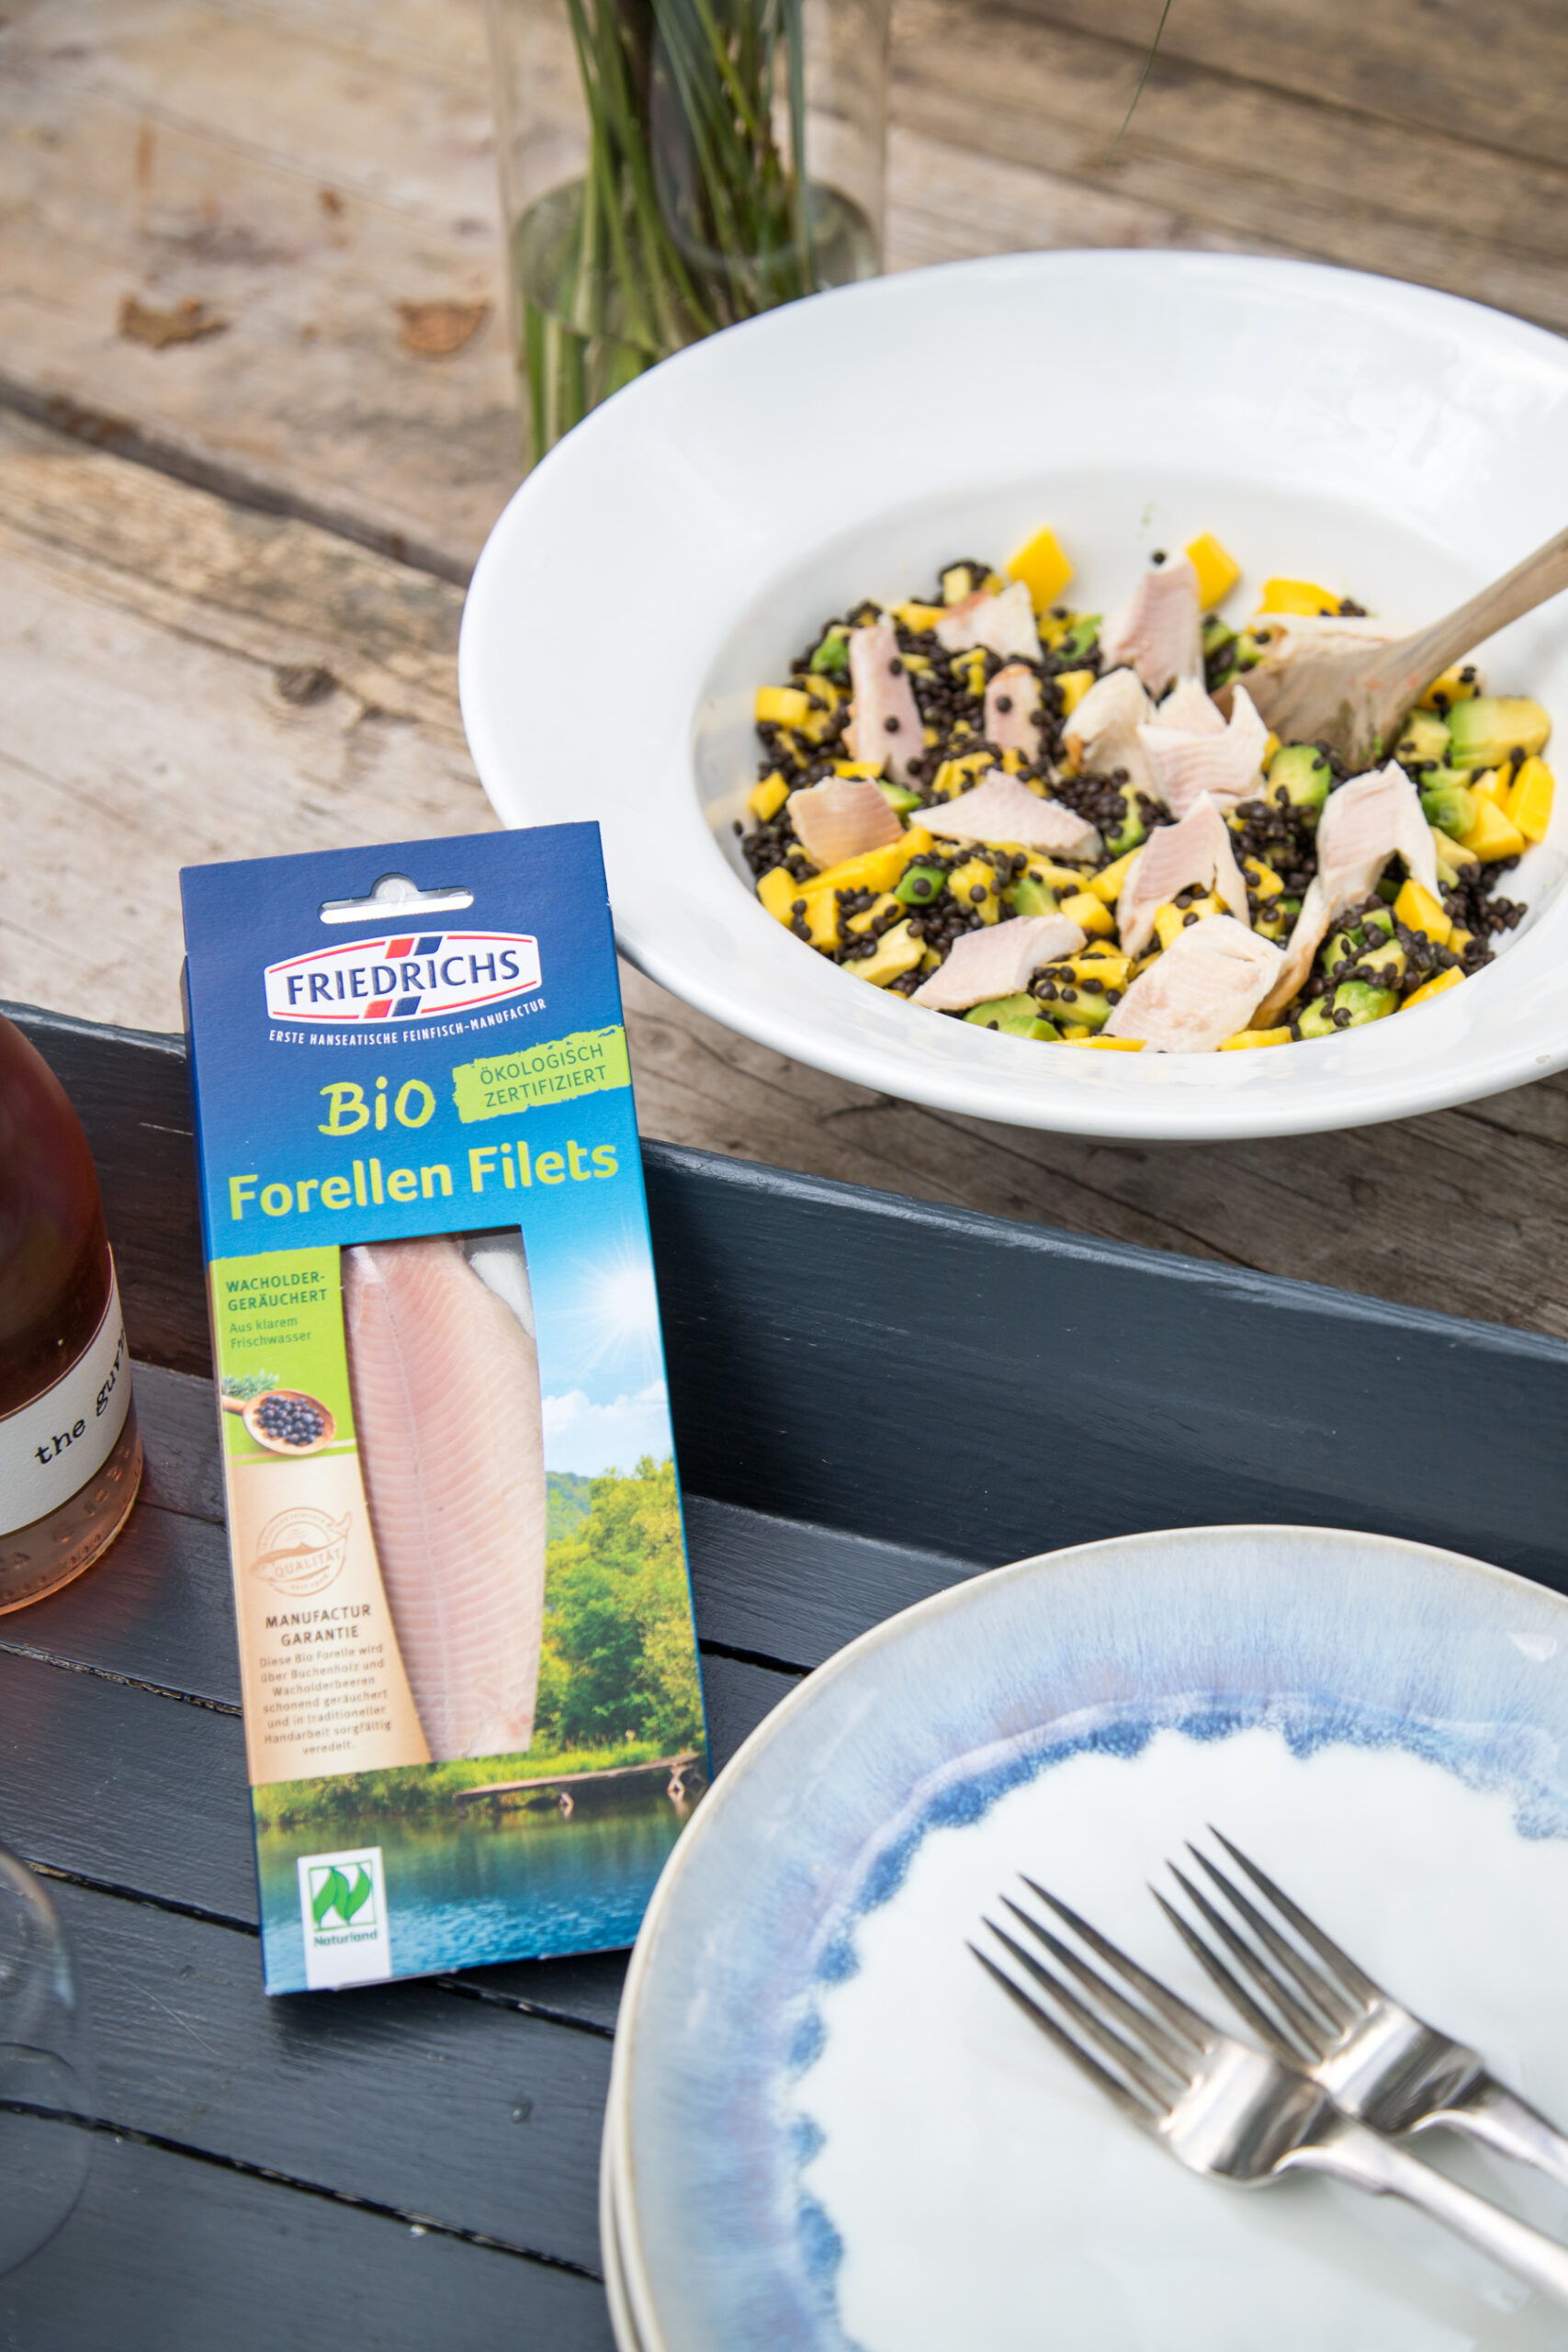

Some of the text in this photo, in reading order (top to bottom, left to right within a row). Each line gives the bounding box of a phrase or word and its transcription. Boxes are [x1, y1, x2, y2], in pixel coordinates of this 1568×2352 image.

[286, 950, 520, 1005] FRIEDRICHS
[269, 998, 547, 1046] ERSTE HANSEATISCHE FEINFISCH-MANUFACTUR
[479, 1043, 604, 1086] ÖKOLOGISCH
[485, 1066, 606, 1109] ZERTIFIZIERT
[228, 1140, 619, 1221] Forellen Filets
[225, 1271, 326, 1294] WACHOLDER-
[227, 1288, 328, 1312] GERÄUCHERT
[229, 1317, 299, 1334] Aus klarem
[231, 1330, 311, 1350] Frischwasser
[34, 1419, 86, 1464] the
[265, 1603, 372, 1629] MANUFACTUR
[280, 1625, 359, 1647] GARANTIE
[259, 1644, 384, 1668] Diese Bio Forelle wird
[260, 1659, 385, 1684] über Buchenholz und
[272, 1676, 376, 1697] Wacholderbeeren
[263, 1689, 389, 1714] schonend geräuchert
[267, 1705, 387, 1729] und in traditioneller
[264, 1720, 392, 1745] Handarbeit sorgfältig
[313, 1929, 378, 1948] Naturland
